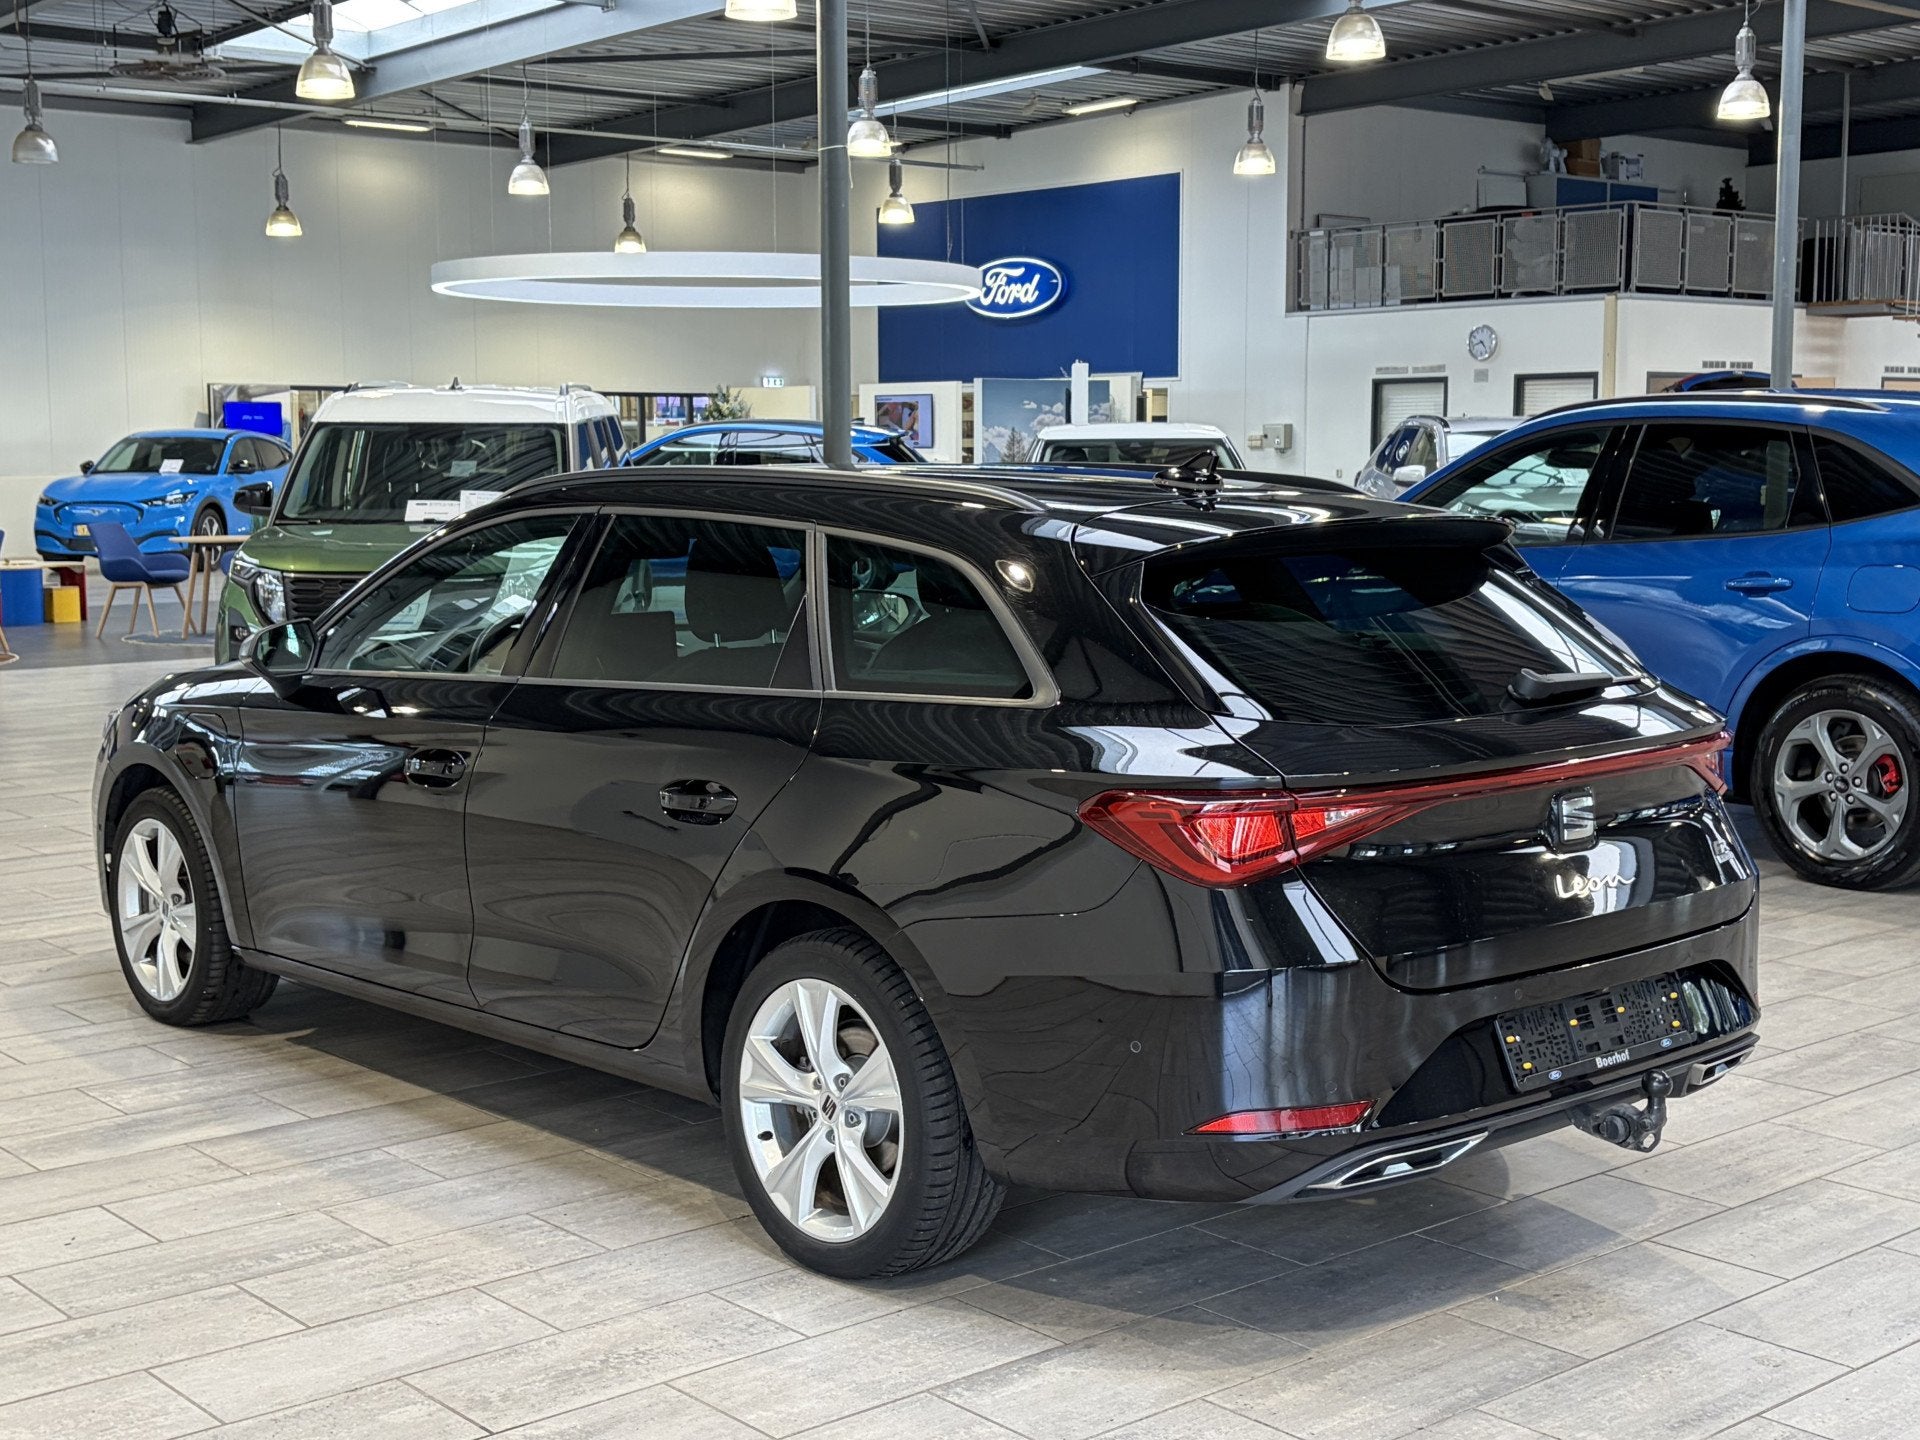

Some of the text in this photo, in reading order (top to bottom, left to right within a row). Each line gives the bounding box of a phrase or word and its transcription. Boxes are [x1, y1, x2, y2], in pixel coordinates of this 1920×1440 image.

[980, 267, 1040, 306] Ford
[1555, 874, 1636, 898] Leon
[1595, 1049, 1630, 1068] Boerhof
